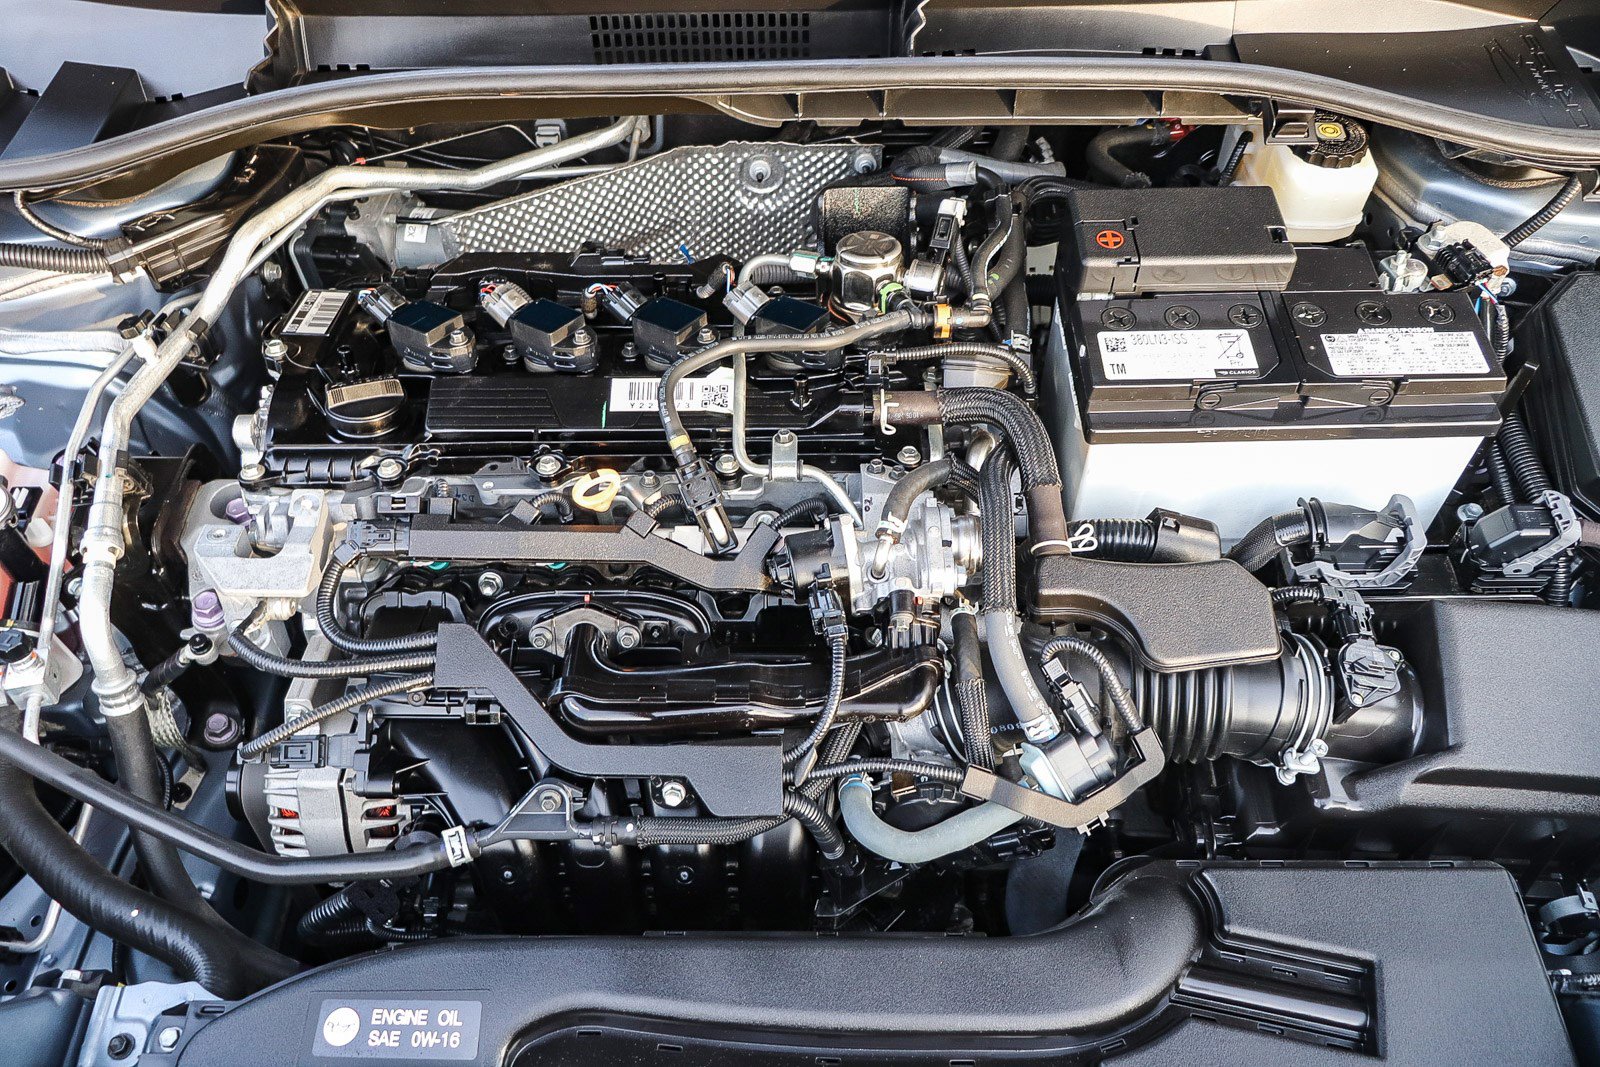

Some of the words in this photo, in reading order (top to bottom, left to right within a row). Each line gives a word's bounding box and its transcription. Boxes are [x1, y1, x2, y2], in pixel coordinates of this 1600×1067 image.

[1109, 363, 1127, 375] TM
[371, 1008, 429, 1026] ENGINE
[437, 1009, 463, 1026] OIL
[367, 1030, 401, 1047] SAE
[411, 1031, 461, 1048] 0W-16
